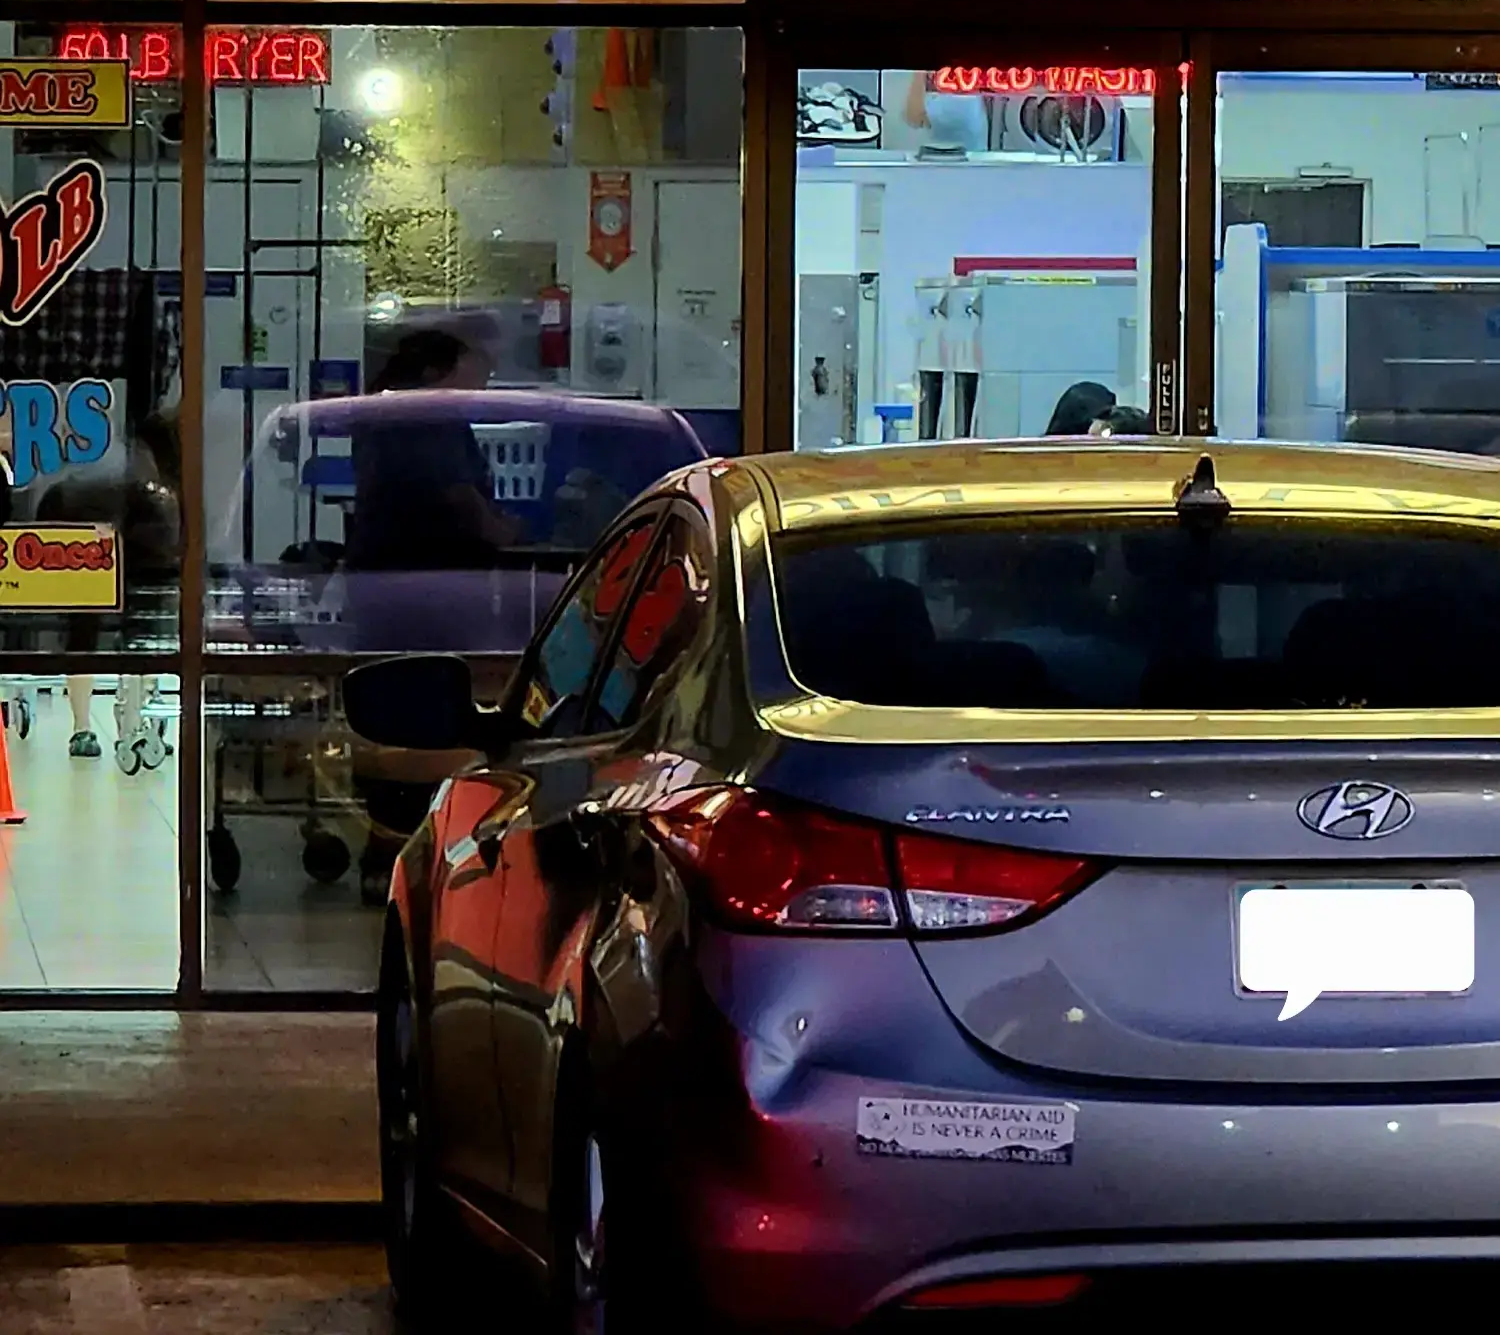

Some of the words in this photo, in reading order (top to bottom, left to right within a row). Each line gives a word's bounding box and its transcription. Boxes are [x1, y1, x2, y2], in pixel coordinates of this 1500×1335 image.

[212, 33, 327, 82] RYER
[10, 171, 96, 314] LB
[0, 380, 112, 488] RS
[902, 1102, 1032, 1123] HUMANITARIAN
[1036, 1111, 1065, 1125] AID
[912, 1122, 925, 1136] IS
[931, 1123, 985, 1139] NEVER
[989, 1126, 1002, 1140] A
[1006, 1127, 1060, 1143] CRIME
